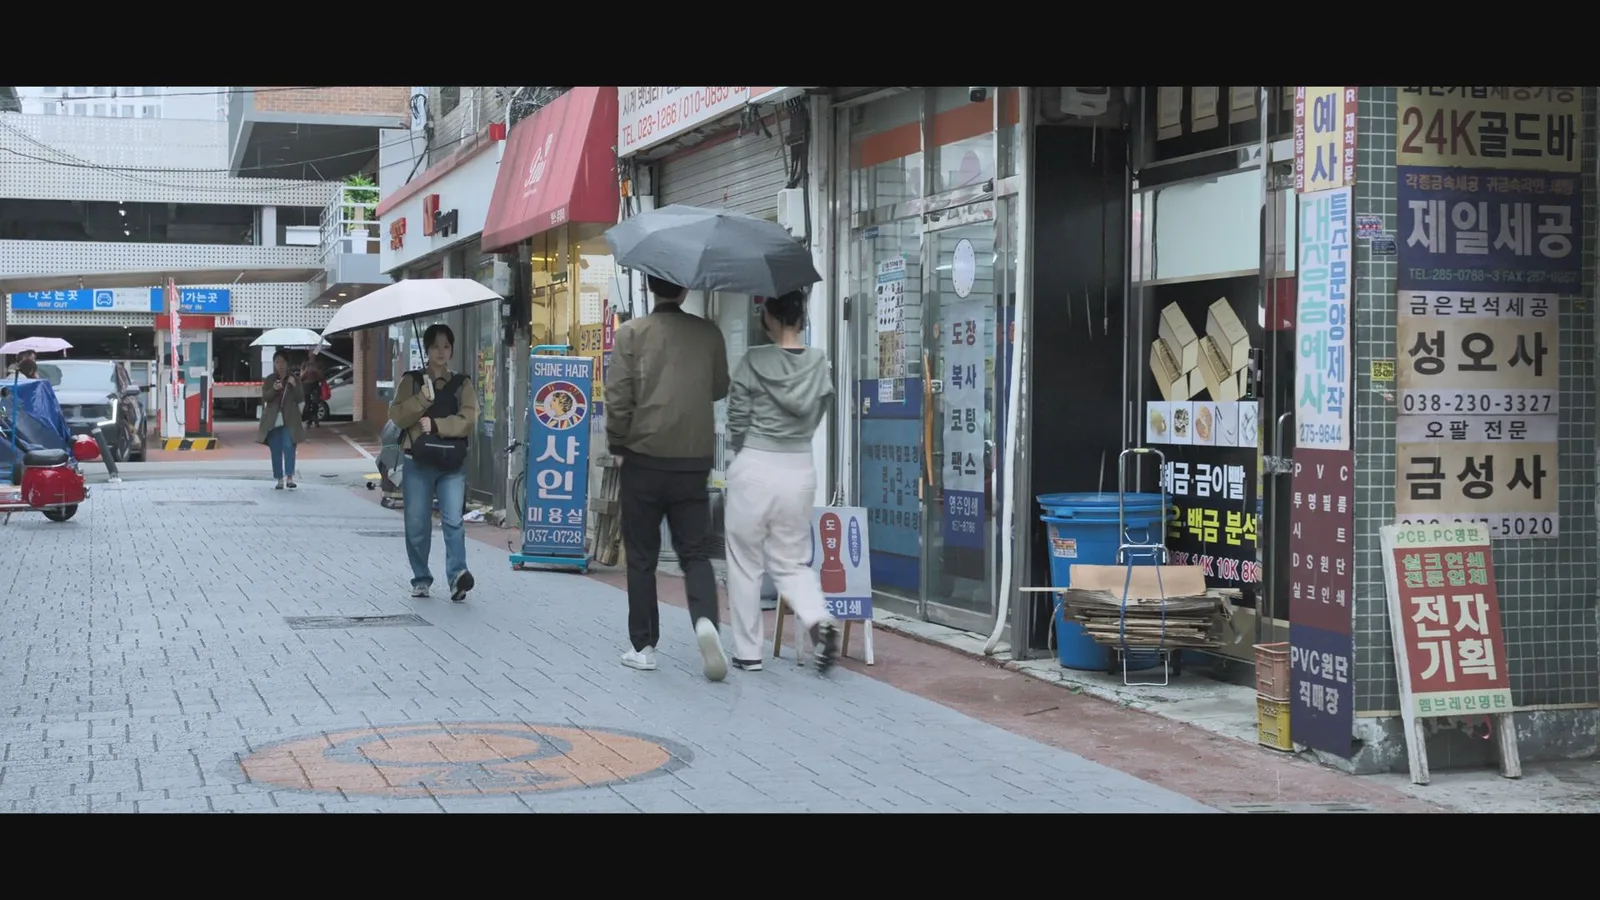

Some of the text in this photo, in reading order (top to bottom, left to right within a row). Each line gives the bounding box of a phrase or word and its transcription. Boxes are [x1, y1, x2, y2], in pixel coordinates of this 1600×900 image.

[637, 103, 677, 140] 023-1266
[1402, 107, 1577, 161] 24K골드바
[1311, 92, 1337, 183] 예사
[1345, 112, 1355, 181] 제작전문
[1406, 199, 1573, 259] 제일세공
[1327, 192, 1348, 419] 특수문양제작
[1410, 295, 1548, 318] 금은보석세공
[951, 320, 976, 346] 도장
[1408, 330, 1548, 376] 성오사
[534, 362, 562, 376] SHINE
[565, 364, 589, 378] HAIR
[951, 364, 977, 390] 복사
[1404, 394, 1551, 412] 038-230-3327
[951, 408, 976, 434] 코팅
[1300, 423, 1342, 443] 275-9644
[1425, 420, 1528, 440] 오팔 전문
[536, 435, 580, 500] 샤인
[951, 451, 976, 477] 팩스
[1405, 455, 1547, 500] 금성사
[528, 506, 582, 525] 미용실
[949, 495, 978, 517] 영주인쇄
[526, 528, 583, 544] 037-0728
[1225, 510, 1258, 549] 분석
[1217, 557, 1240, 581] 10K
[1241, 560, 1258, 583] 8K
[1404, 568, 1489, 589] 전문업체
[1292, 582, 1346, 607] 실크인쇄
[824, 600, 862, 616] 주인쇄
[1411, 593, 1490, 638] 전자
[1290, 645, 1348, 684] PVC원단
[1417, 638, 1498, 683] 기획
[1299, 680, 1339, 715] 직매장
[1419, 694, 1506, 713] 멤브레인명판
